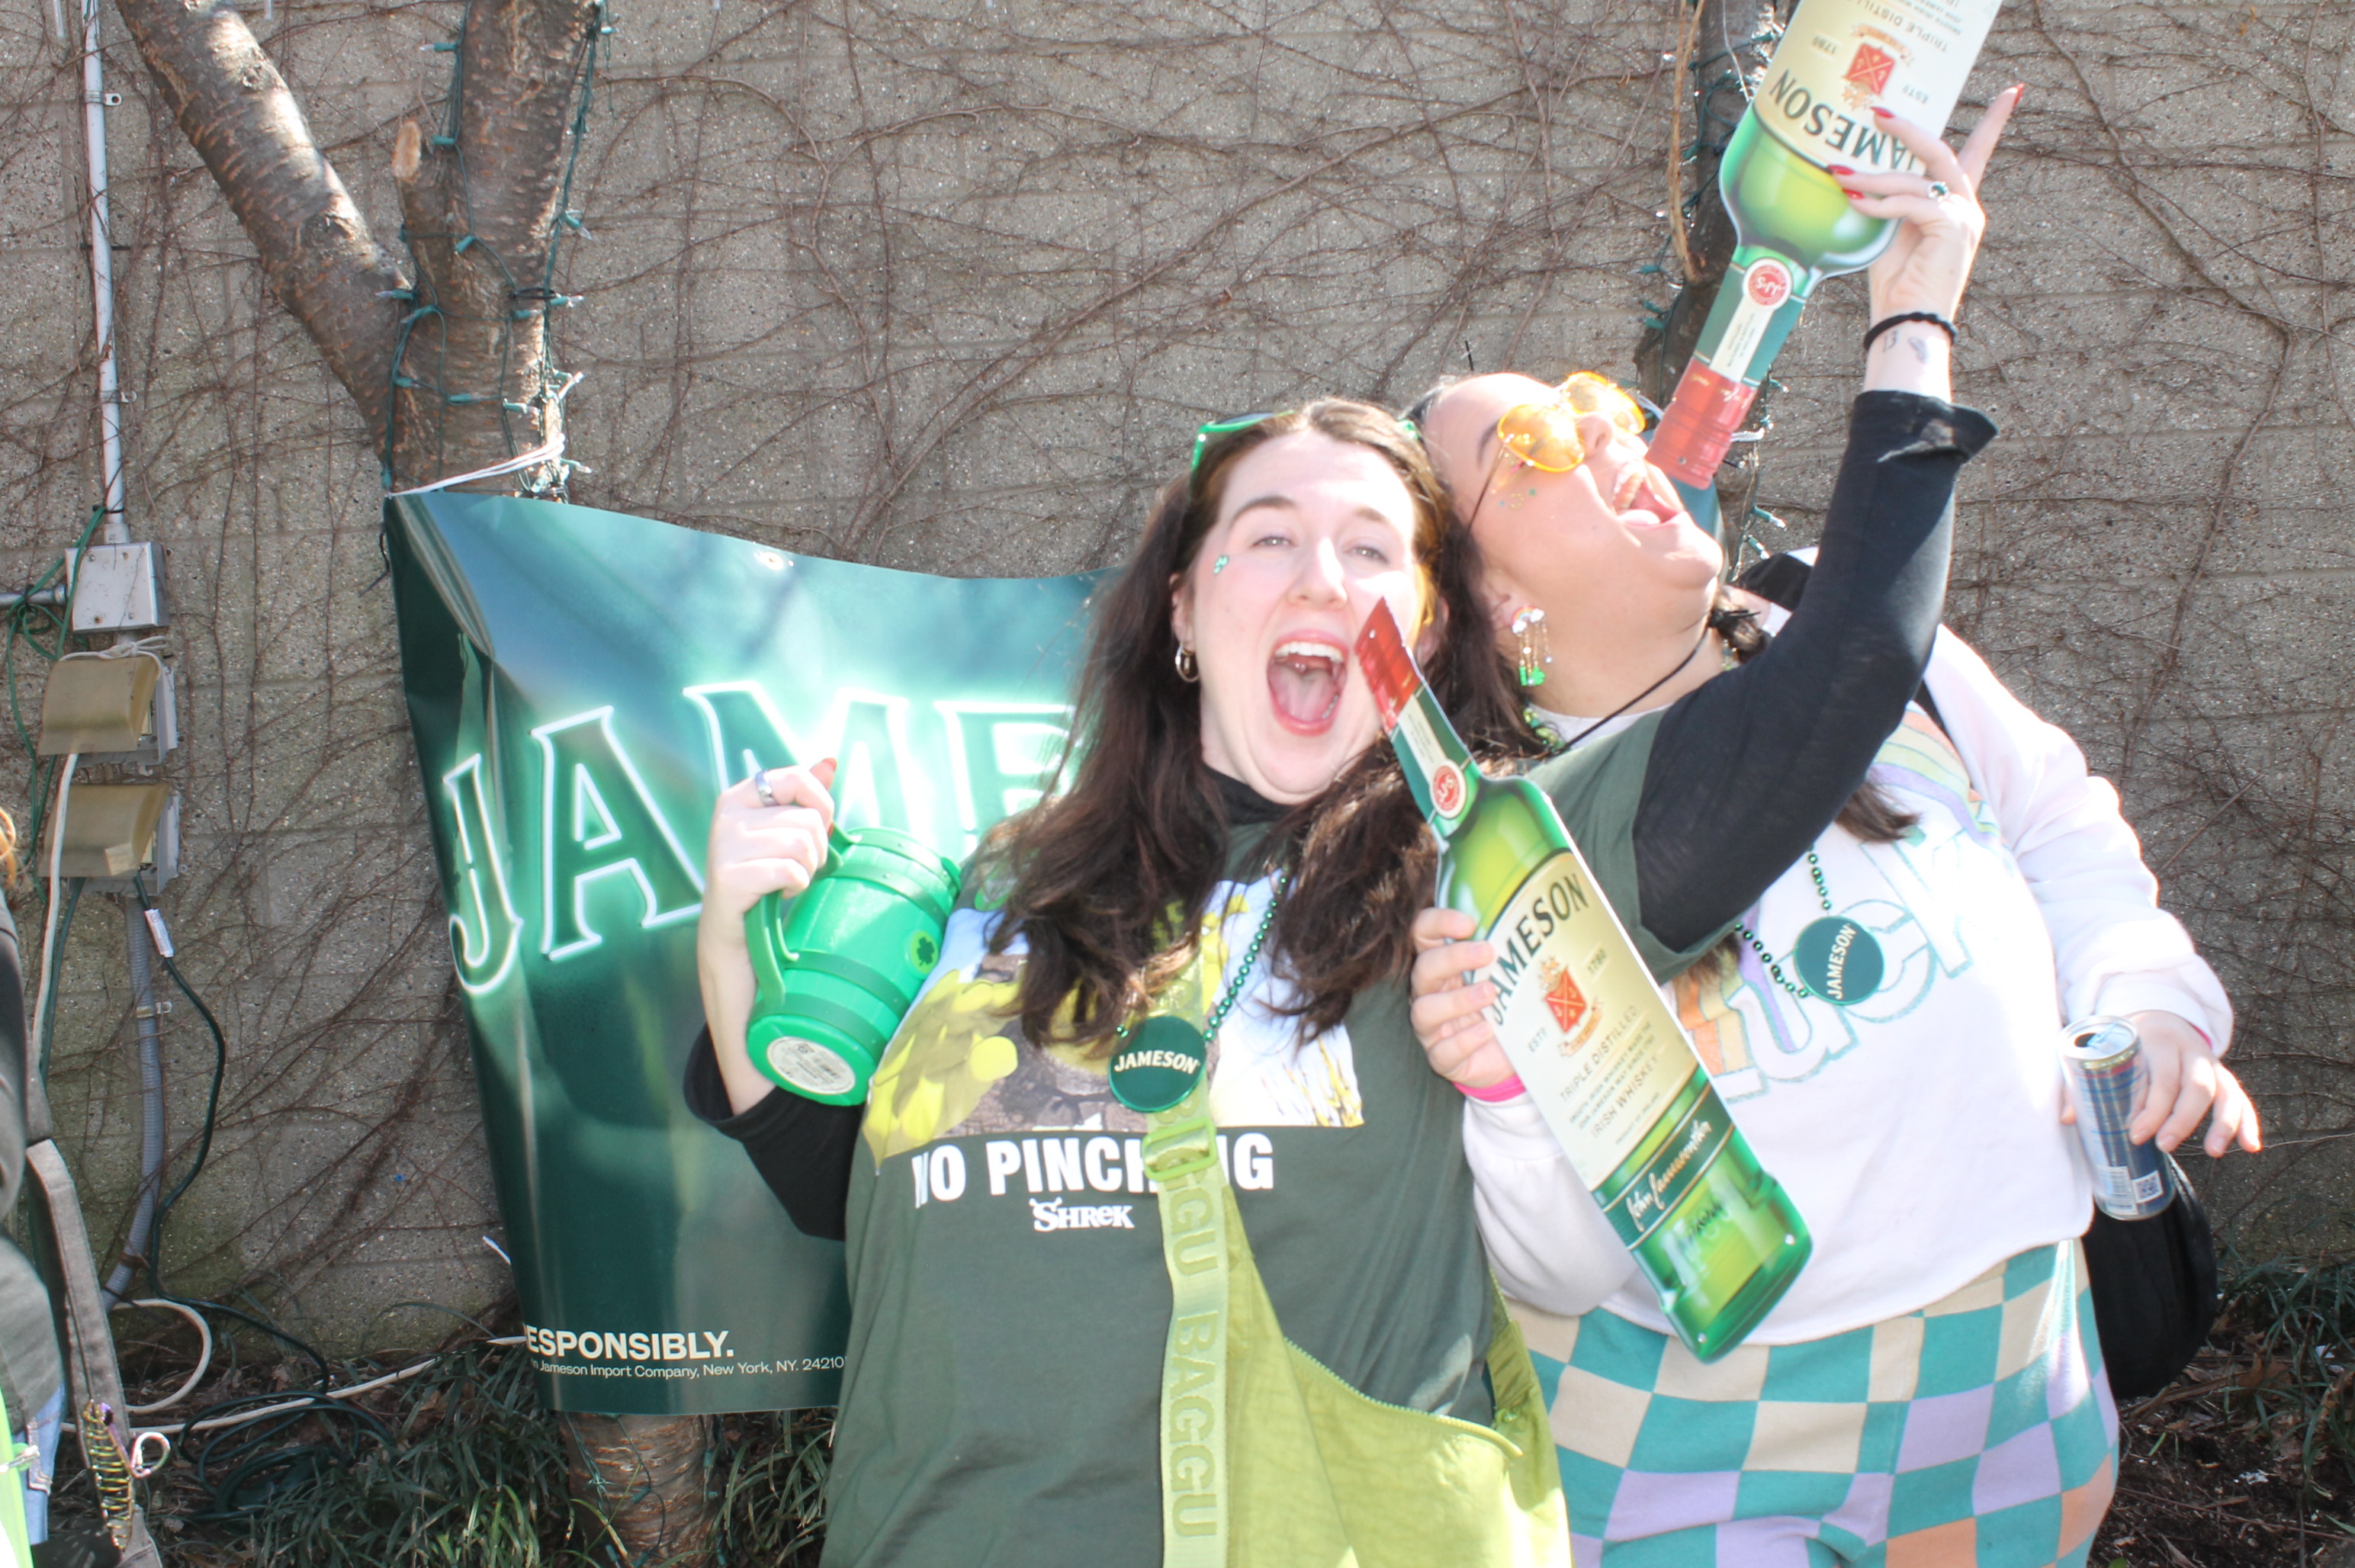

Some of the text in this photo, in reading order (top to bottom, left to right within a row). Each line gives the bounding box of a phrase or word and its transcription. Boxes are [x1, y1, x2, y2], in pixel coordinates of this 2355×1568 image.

[1826, 924, 1856, 1000] JAMESON
[1113, 1049, 1200, 1075] JAMESON
[1560, 1060, 1592, 1104] TRIPLE
[1589, 1001, 1639, 1066] DISTILLED
[1591, 1051, 1659, 1141] IRISH WHISKEY
[524, 1324, 734, 1361] ESPONSIBLY.
[539, 1361, 588, 1375] Jameson
[590, 1364, 631, 1379] Import
[635, 1364, 700, 1380] Company,
[703, 1364, 734, 1376] New
[737, 1361, 773, 1374] York,
[776, 1359, 799, 1372] NY.
[802, 1356, 847, 1370] 24210
[1168, 1310, 1219, 1538] BAGGU
